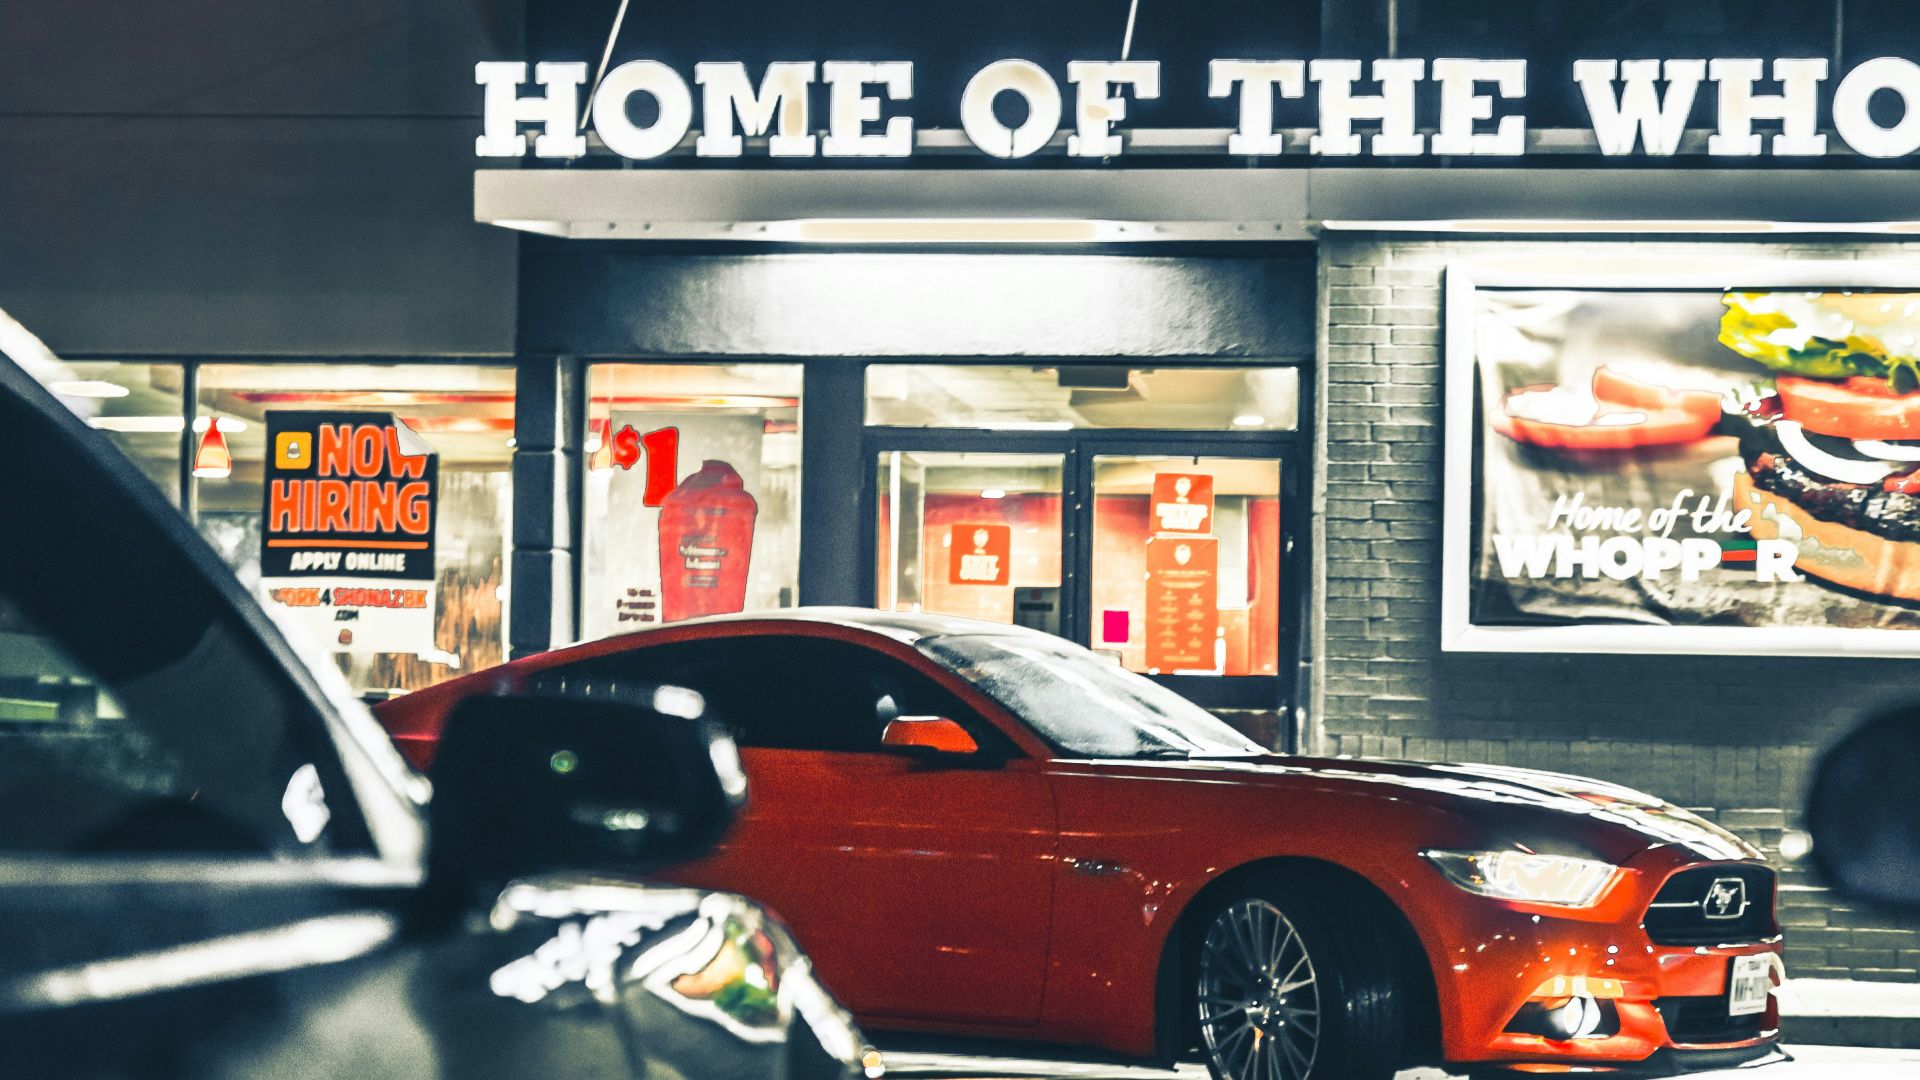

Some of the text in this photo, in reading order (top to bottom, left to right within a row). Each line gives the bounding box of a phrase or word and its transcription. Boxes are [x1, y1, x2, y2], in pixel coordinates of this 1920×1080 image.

[475, 56, 1920, 158] HOME OF THE WHO
[318, 423, 428, 478] NOW
[613, 424, 679, 507] $1
[269, 479, 430, 535] HIRING
[1548, 488, 1753, 539] Home of the
[290, 552, 406, 572] APPLY ONLINE
